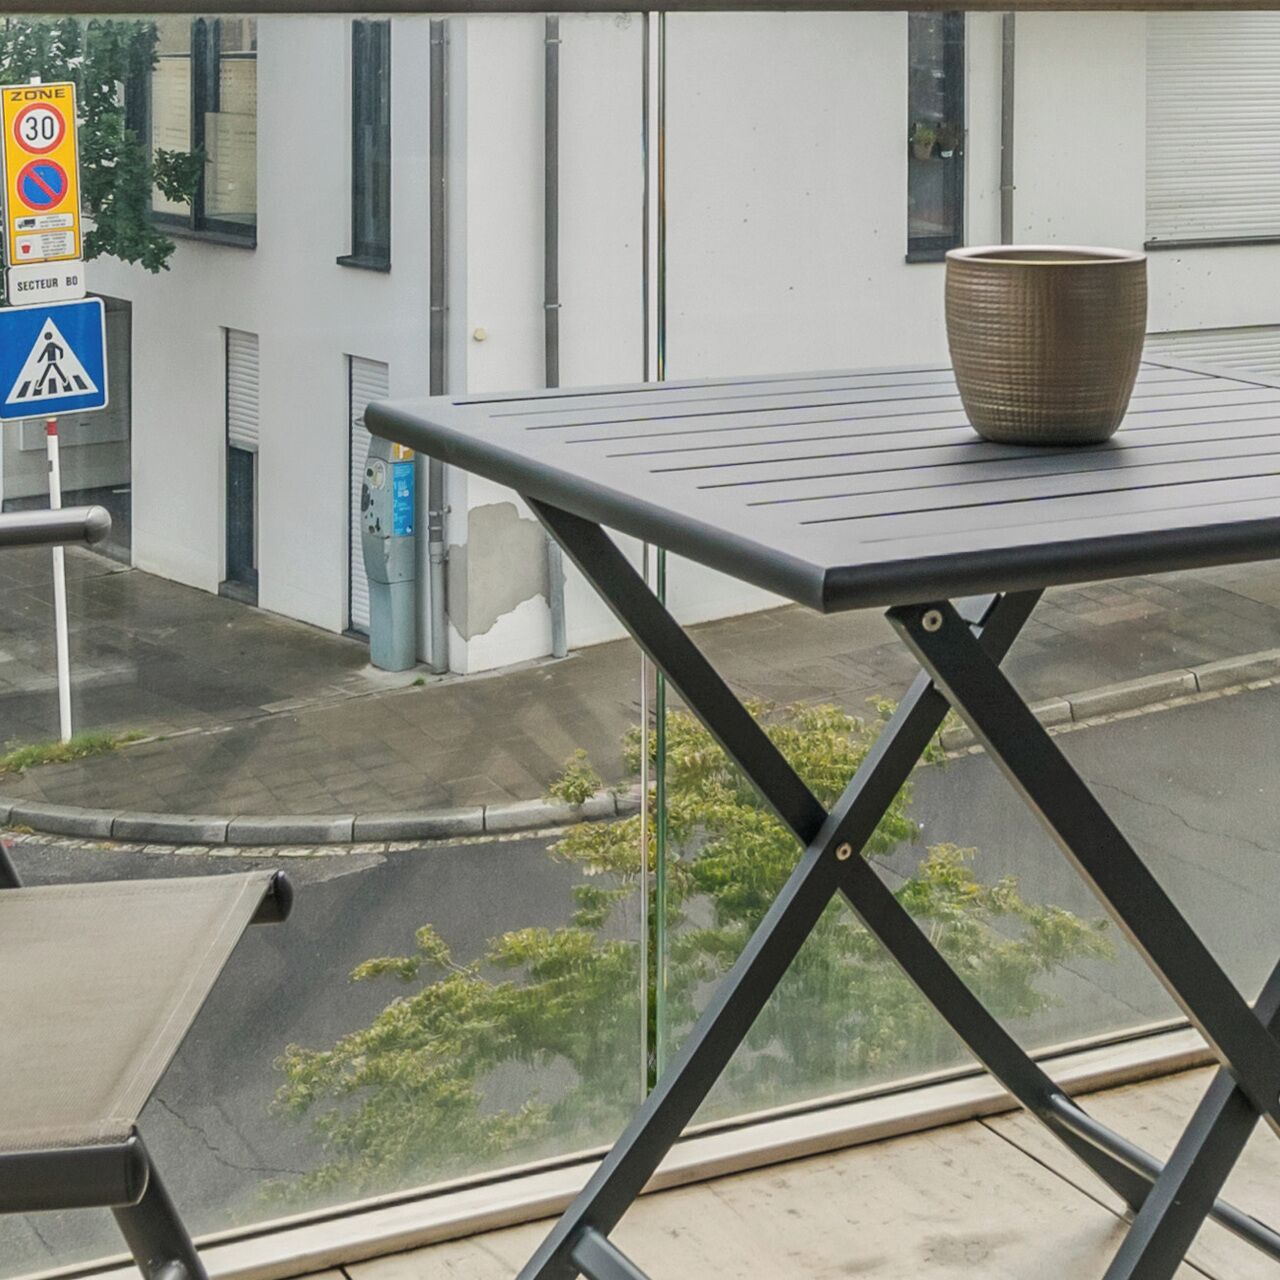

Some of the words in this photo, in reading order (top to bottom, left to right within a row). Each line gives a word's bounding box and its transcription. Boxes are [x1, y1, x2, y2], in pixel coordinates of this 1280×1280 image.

[11, 89, 66, 102] ZONE
[25, 116, 55, 141] 30
[17, 278, 59, 292] SECTEUR
